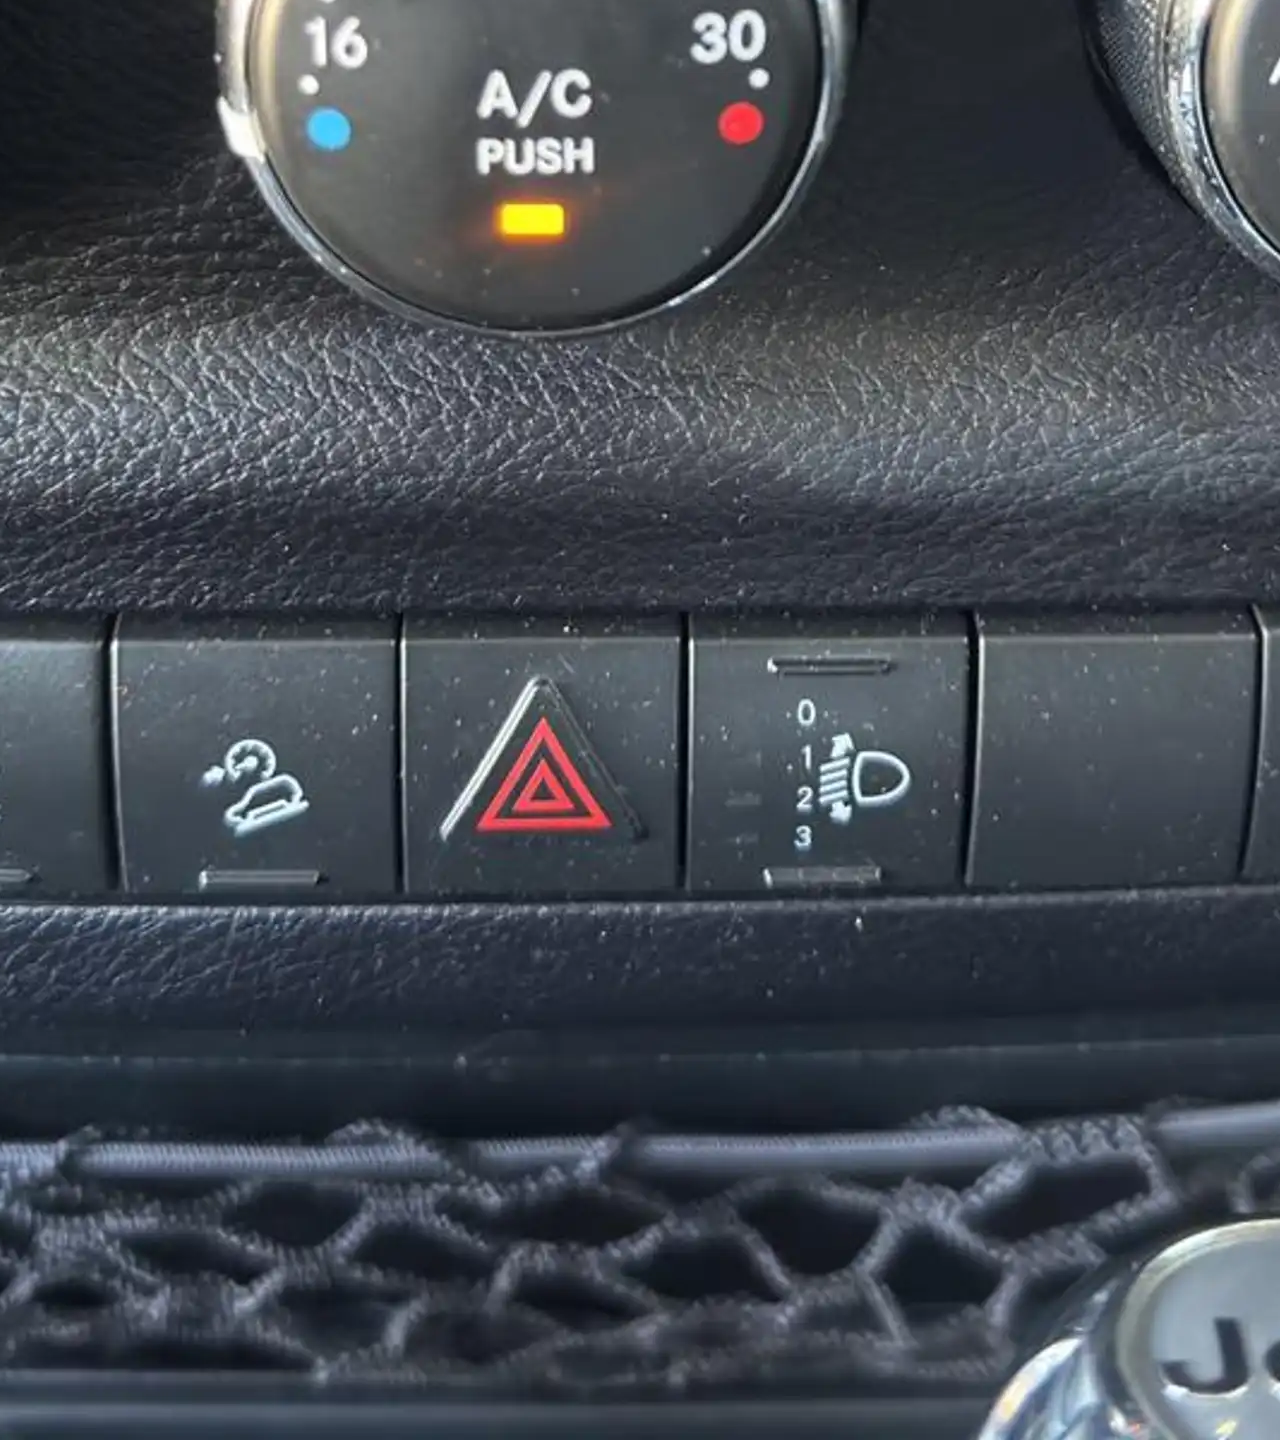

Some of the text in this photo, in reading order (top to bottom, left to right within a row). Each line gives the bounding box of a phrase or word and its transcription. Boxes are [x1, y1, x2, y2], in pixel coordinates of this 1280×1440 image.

[304, 16, 370, 69] 16
[688, 10, 768, 65] 30
[476, 69, 594, 128] A/C
[476, 137, 596, 176] PUSH
[800, 744, 813, 771] 1
[795, 785, 815, 812] 2
[793, 824, 813, 851] 3
